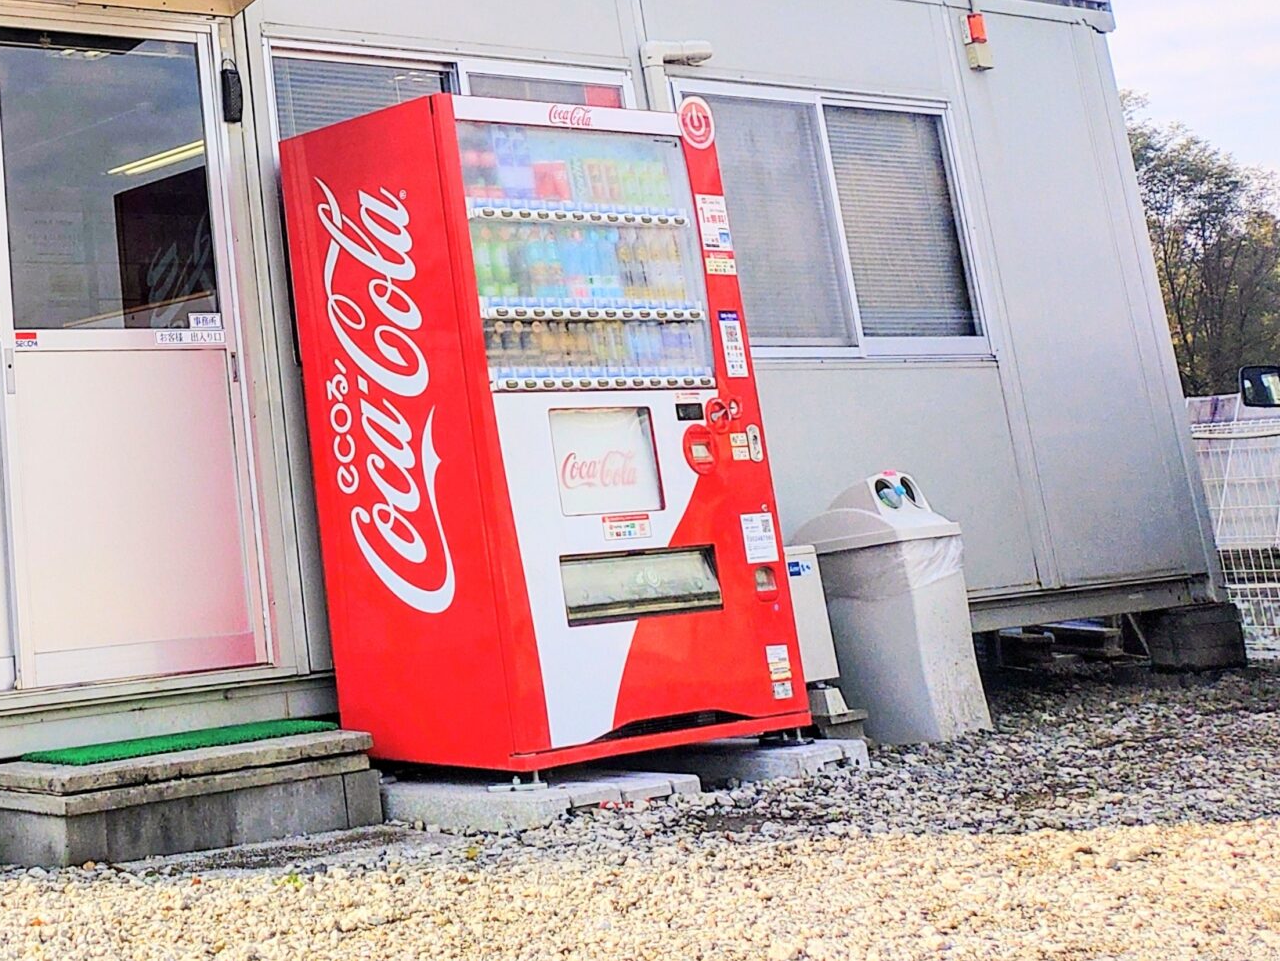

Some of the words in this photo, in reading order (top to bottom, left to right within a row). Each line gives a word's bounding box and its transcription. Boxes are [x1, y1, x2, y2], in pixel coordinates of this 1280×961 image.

[548, 104, 592, 126] Coca-Cola
[190, 332, 222, 342] 出入り口
[313, 176, 455, 613] Coca-Cola
[561, 450, 637, 489] Coca-Cola
